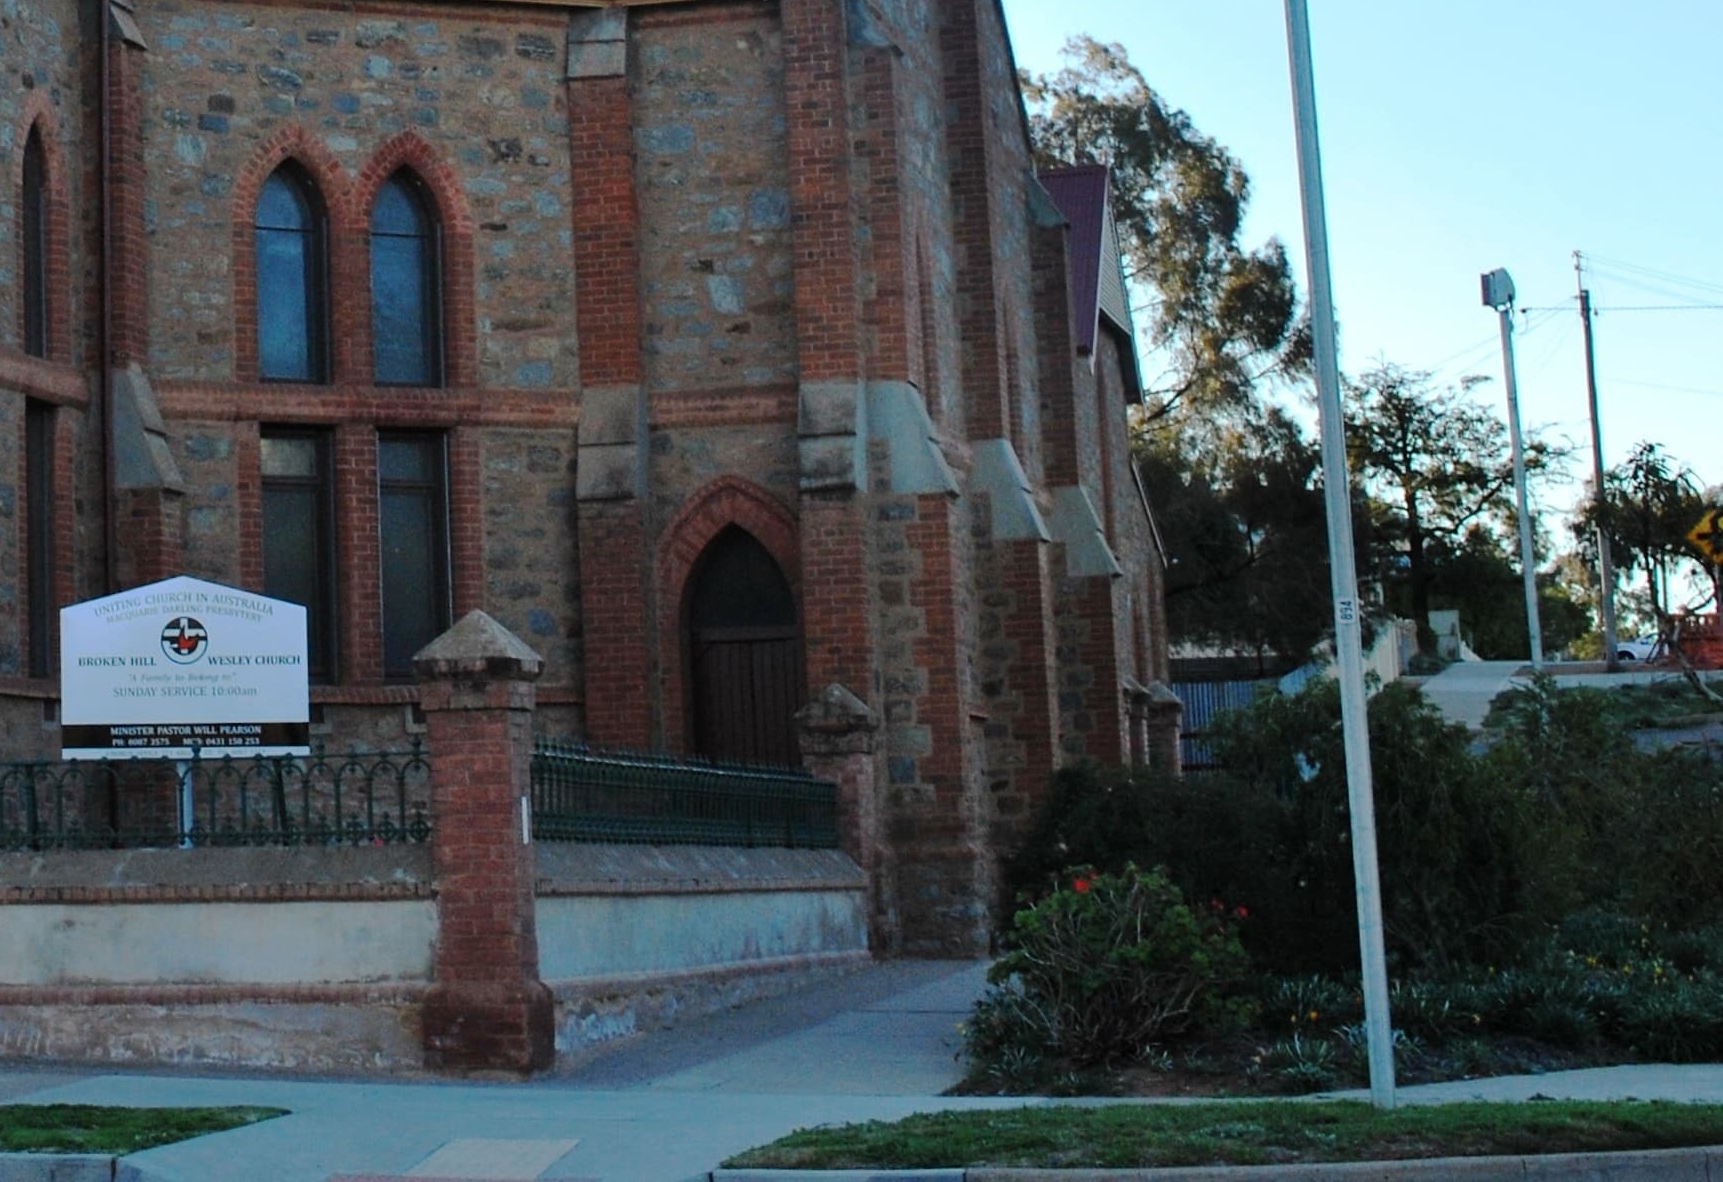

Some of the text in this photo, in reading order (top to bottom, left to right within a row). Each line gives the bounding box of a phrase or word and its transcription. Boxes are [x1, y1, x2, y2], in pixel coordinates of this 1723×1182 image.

[94, 592, 274, 617] UNITING CHURCH IN AUSTRALIA
[106, 605, 262, 623] MACQUARIE DARLING PRESBYTERY
[78, 656, 157, 667] BROKEN HILL
[208, 655, 301, 666] WESLEY CHURCH
[113, 685, 257, 697] SUNDAY SERVICE 10:00am
[110, 725, 261, 736] MINISTER PASTOR WILL PEARSON
[206, 737, 225, 745] 0431
